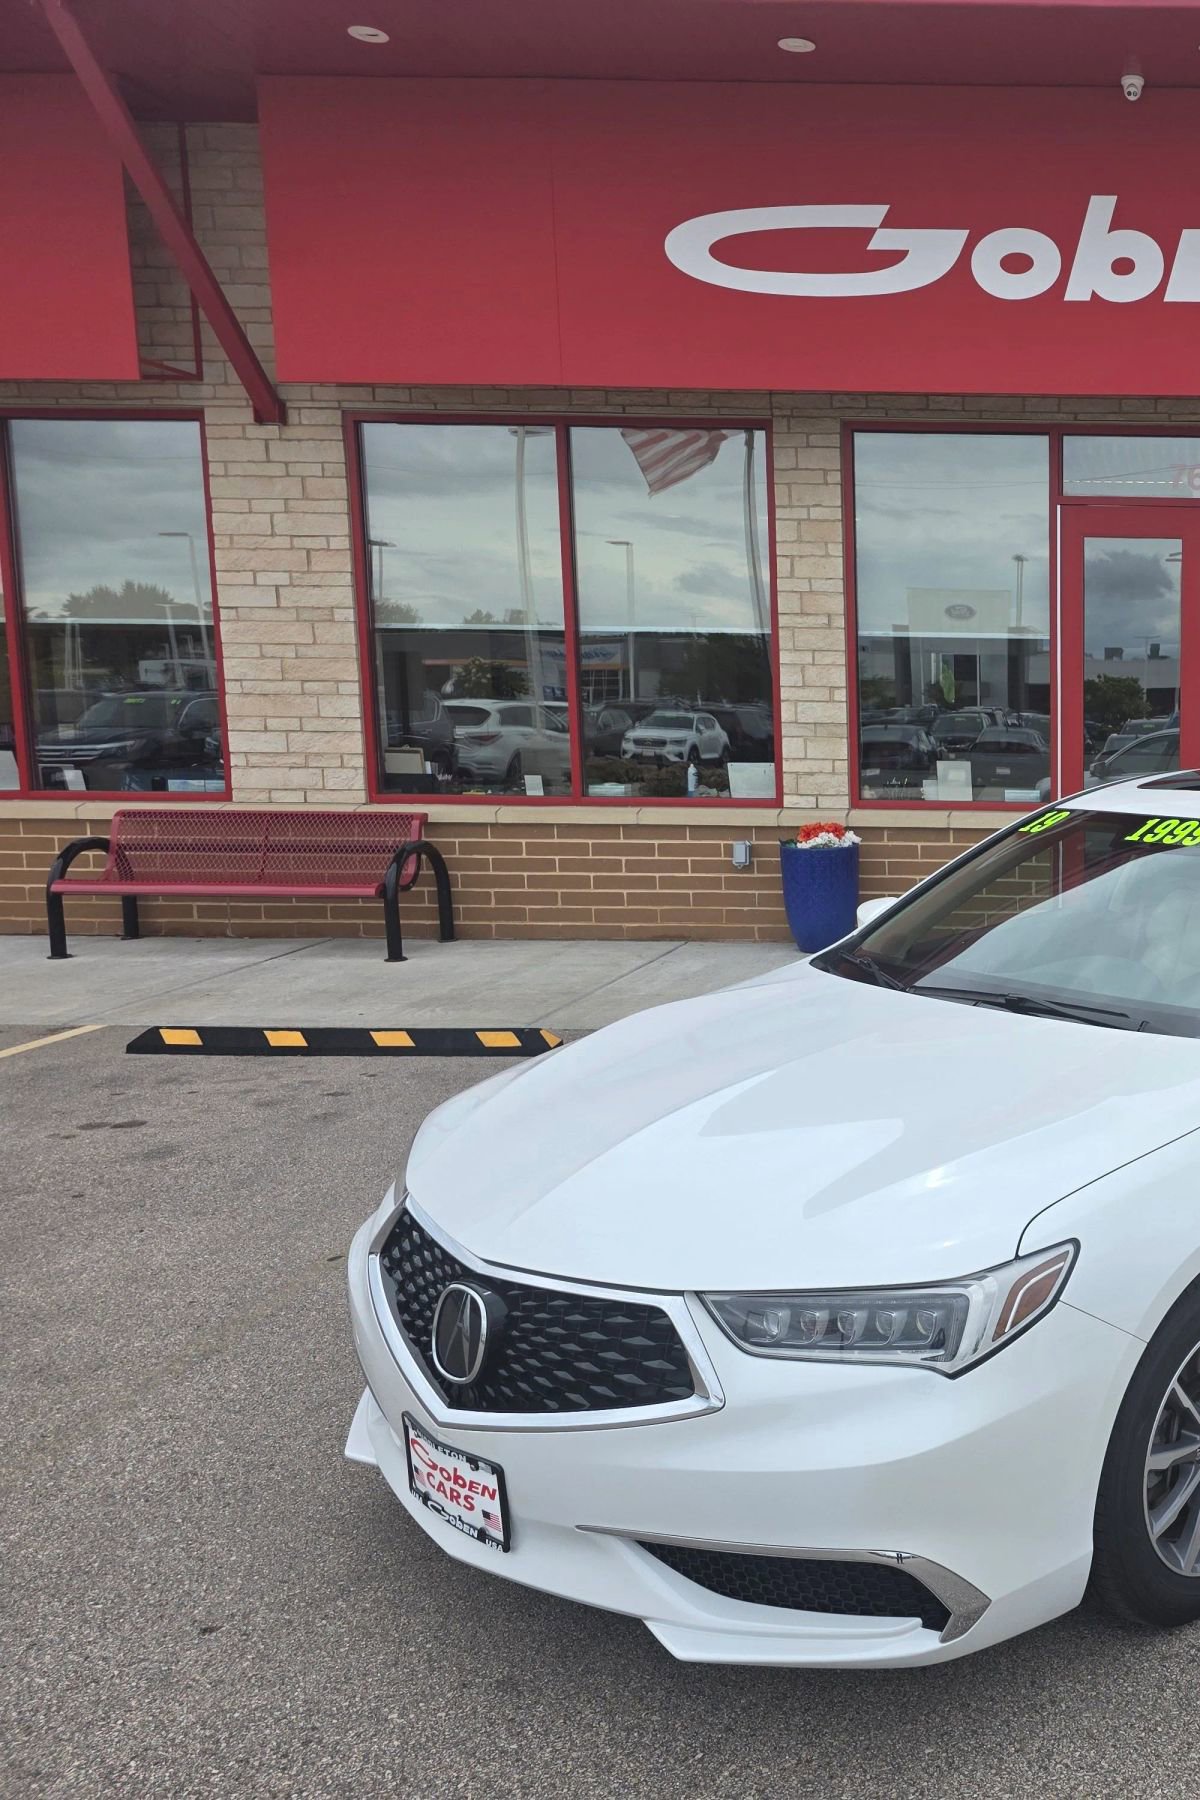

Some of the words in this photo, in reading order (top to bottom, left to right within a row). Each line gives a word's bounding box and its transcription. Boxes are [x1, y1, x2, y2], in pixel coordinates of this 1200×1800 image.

[1018, 811, 1071, 833] 19
[426, 1471, 476, 1512] CARS
[485, 1538, 504, 1552] USA
